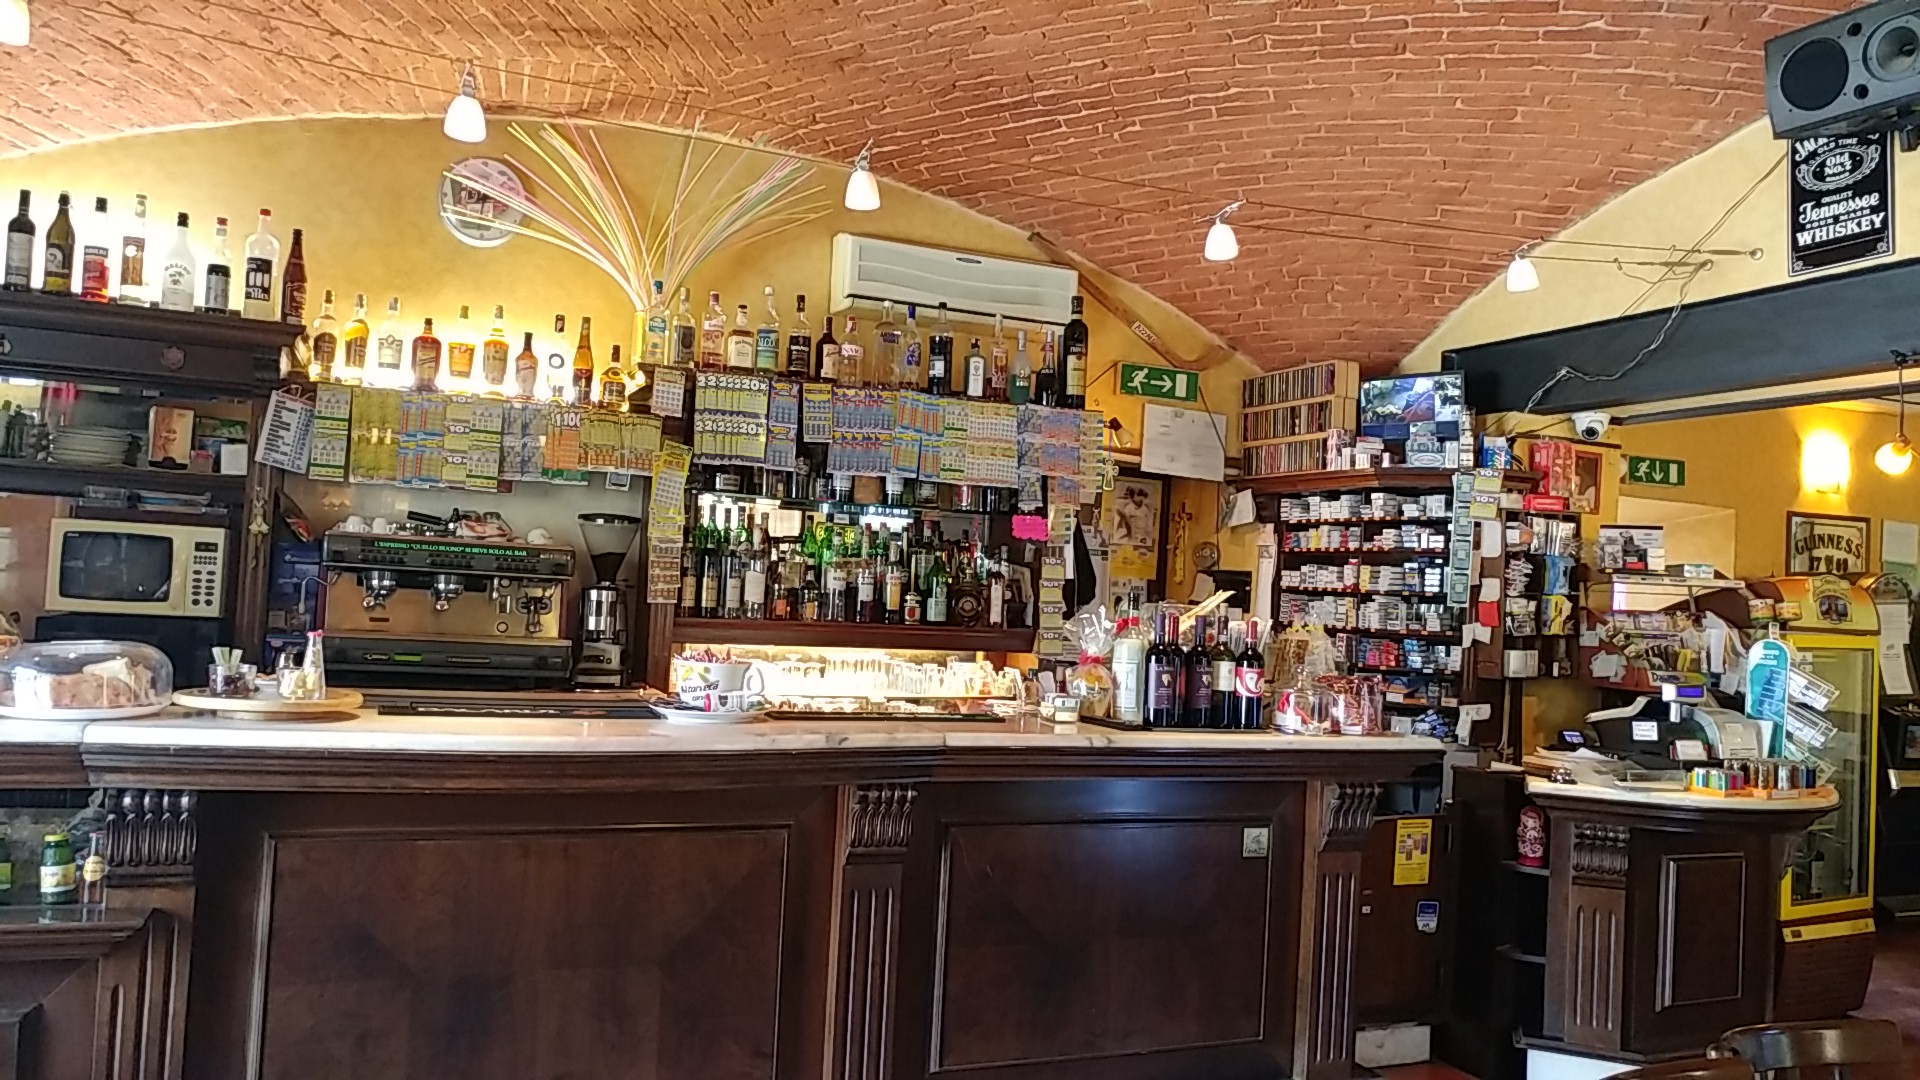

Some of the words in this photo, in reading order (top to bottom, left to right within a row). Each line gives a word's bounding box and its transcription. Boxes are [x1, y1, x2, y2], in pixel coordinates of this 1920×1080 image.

[1817, 142, 1836, 154] OLD
[1838, 137, 1859, 146] TIME
[1824, 160, 1853, 176] No.7
[1826, 152, 1850, 167] Old
[1821, 190, 1854, 204] QUALITY
[1798, 192, 1880, 224] Tennessee
[1805, 217, 1835, 229] SOUR
[1838, 208, 1871, 221] MASH
[1795, 211, 1886, 247] WHISKEY
[488, 548, 505, 556] SOLO
[514, 549, 528, 557] BAR
[1795, 532, 1864, 560] GUINNESS
